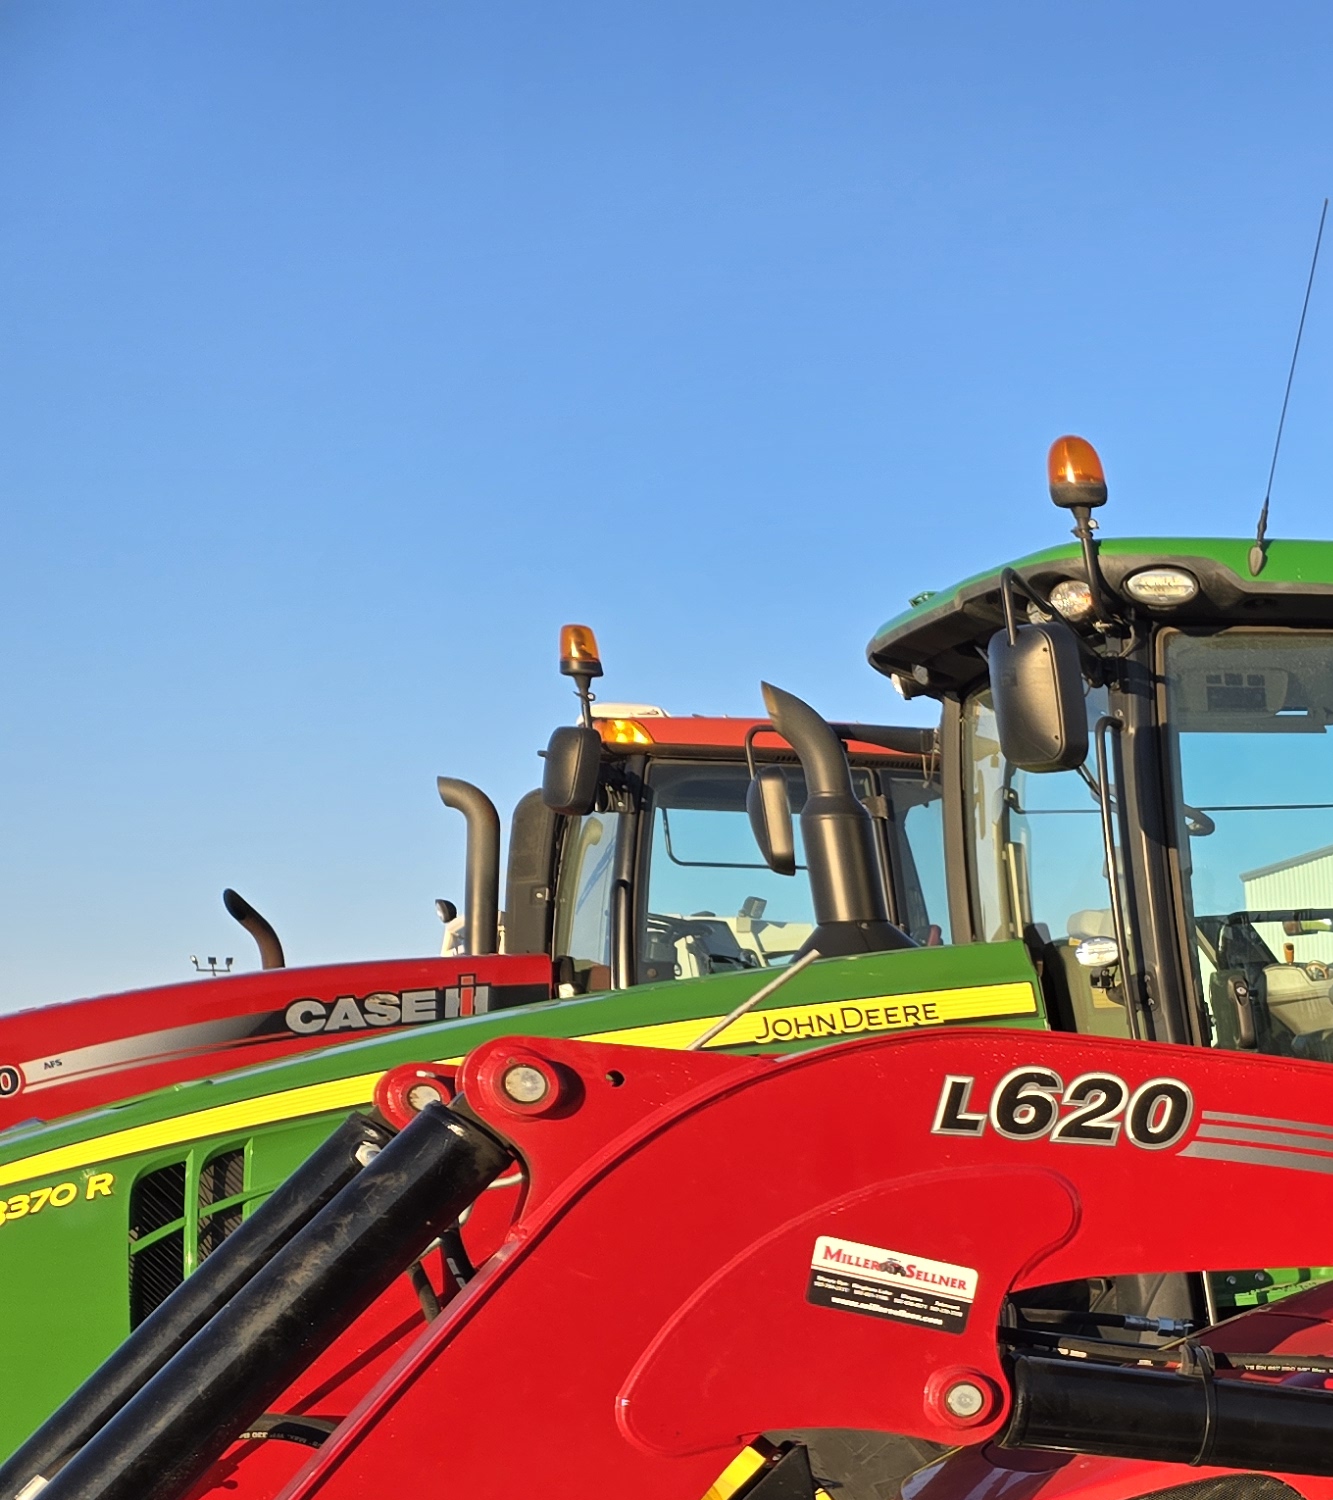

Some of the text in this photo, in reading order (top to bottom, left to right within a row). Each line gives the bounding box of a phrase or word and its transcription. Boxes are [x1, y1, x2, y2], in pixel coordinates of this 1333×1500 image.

[285, 989, 437, 1034] CASE
[755, 1003, 939, 1040] JOHN DEERE
[43, 1059, 63, 1070] AFS
[930, 1065, 1195, 1150] L620
[85, 1172, 114, 1201] R
[823, 1245, 967, 1291] MILLER SELLNER
